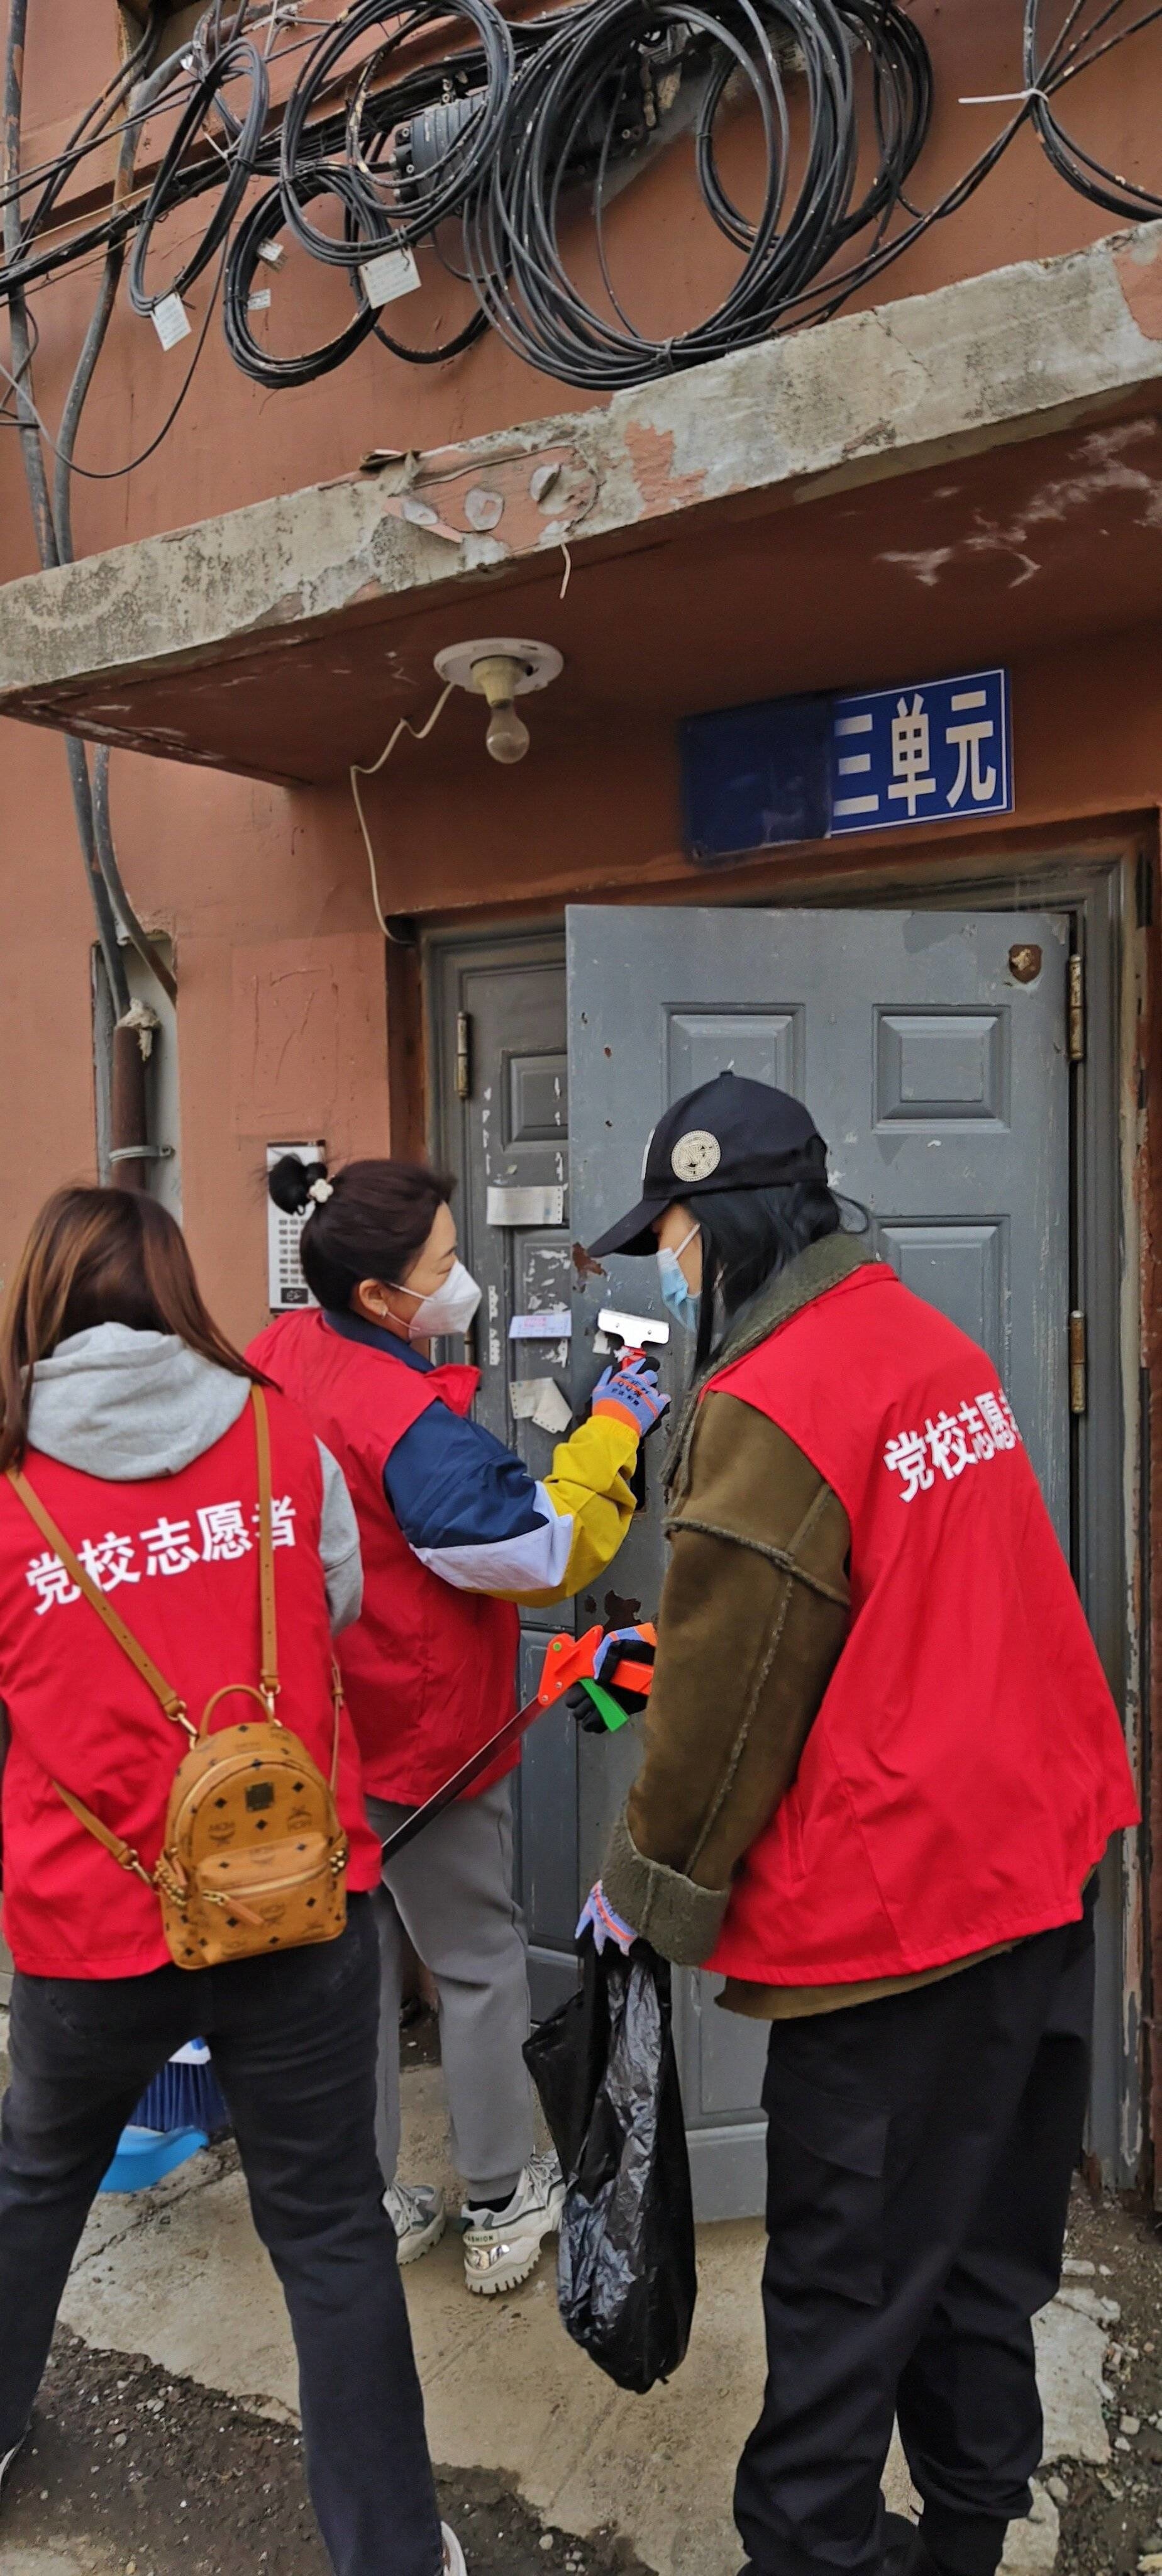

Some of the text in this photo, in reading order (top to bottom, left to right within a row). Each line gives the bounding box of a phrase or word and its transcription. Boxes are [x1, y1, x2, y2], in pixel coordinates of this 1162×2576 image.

[833, 692, 997, 816] 三单元
[25, 1495, 297, 1616] 党校志愿者
